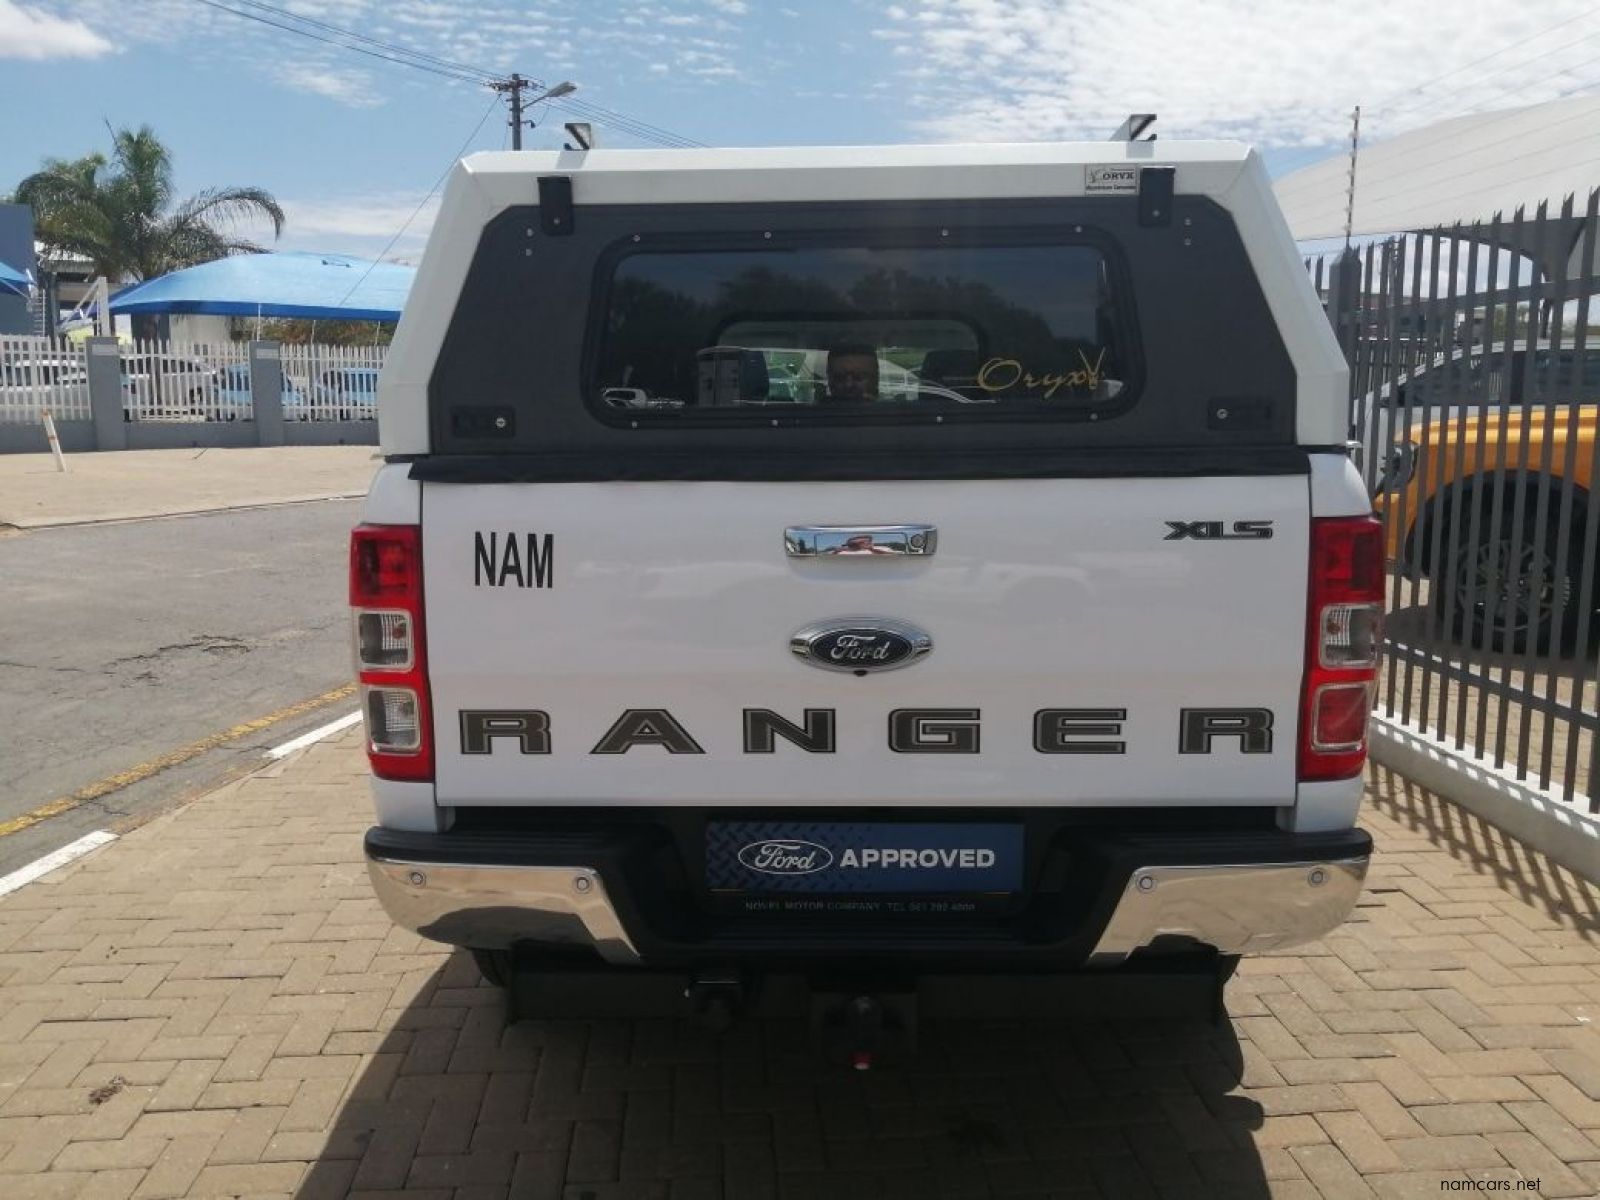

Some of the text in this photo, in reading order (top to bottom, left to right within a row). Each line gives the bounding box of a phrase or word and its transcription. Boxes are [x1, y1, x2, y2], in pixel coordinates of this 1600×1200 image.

[1103, 172, 1134, 181] ORYX
[1163, 521, 1274, 540] XLS
[475, 532, 553, 588] NAM
[830, 634, 890, 659] Ford
[458, 708, 1275, 755] RANGER
[754, 843, 996, 869] Ford APPROVED
[785, 901, 824, 911] MOTOR
